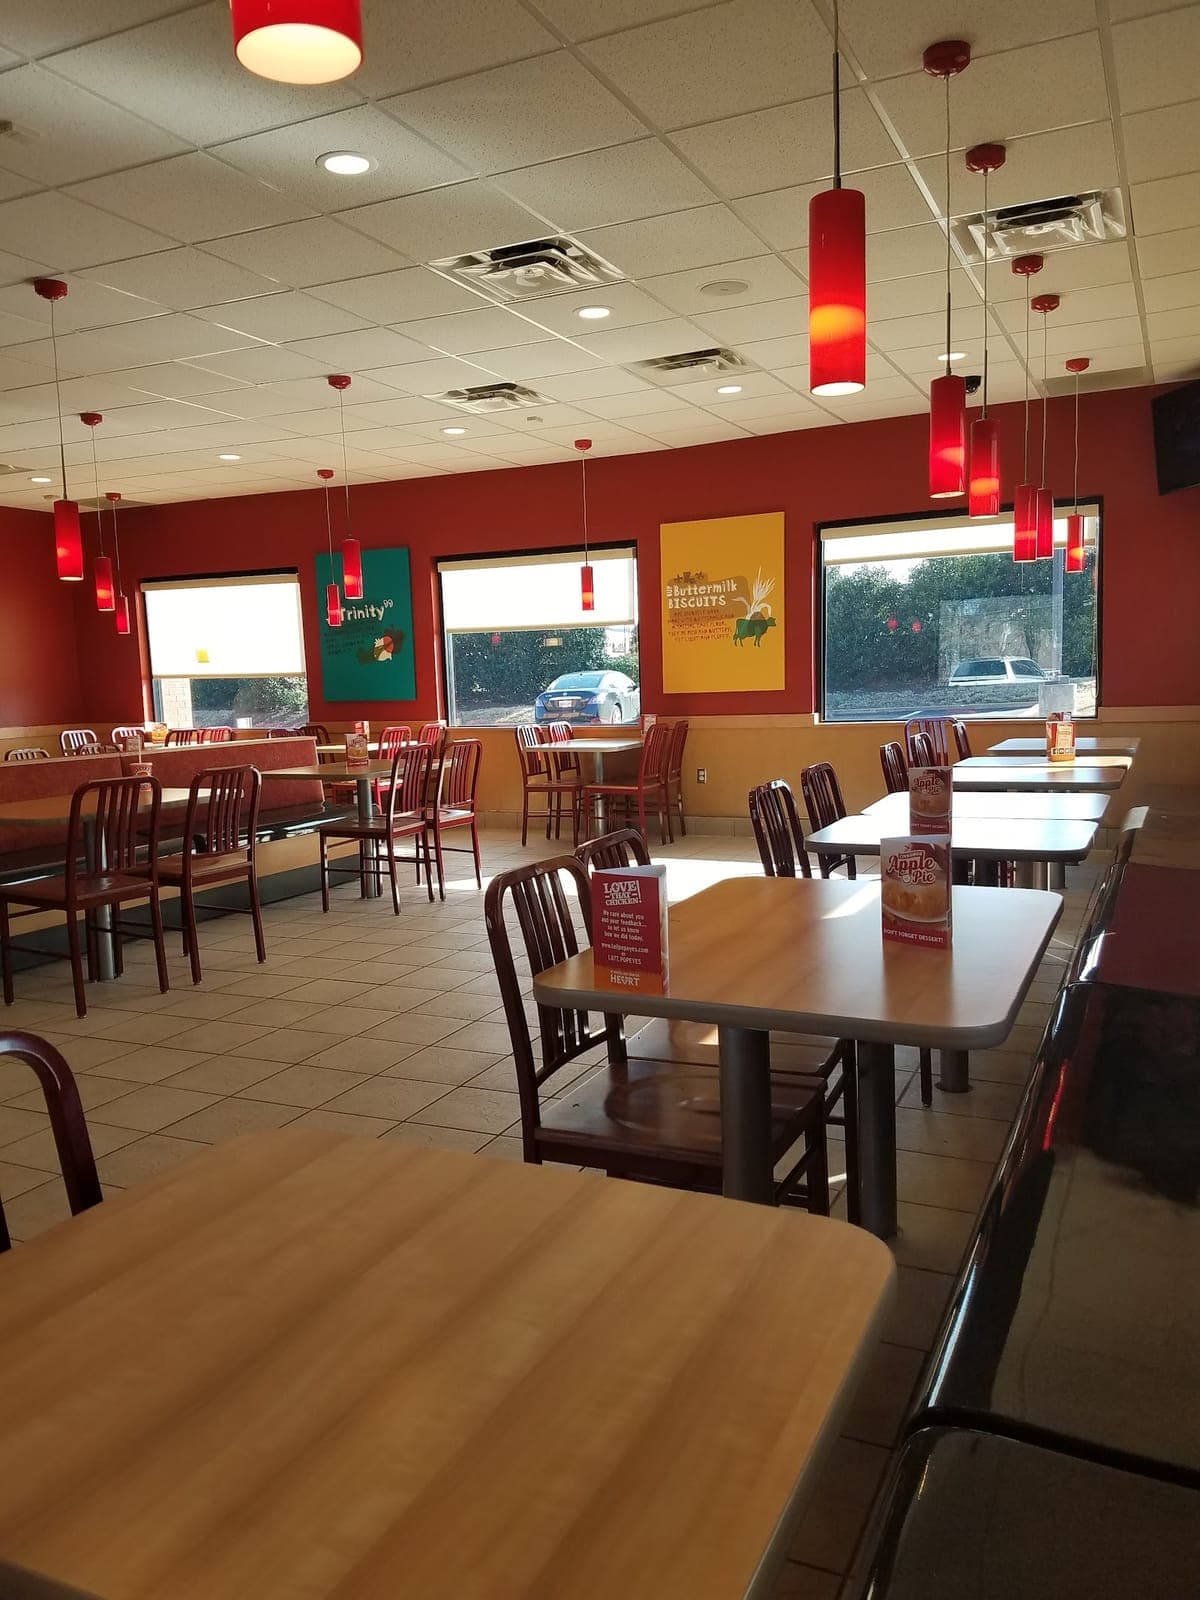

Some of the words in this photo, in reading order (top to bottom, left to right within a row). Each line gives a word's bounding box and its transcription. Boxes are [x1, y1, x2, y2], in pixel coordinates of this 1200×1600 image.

[673, 579, 737, 597] Buttermilk
[668, 596, 727, 609] BISCUITS
[887, 852, 936, 877] Apple
[911, 869, 936, 885] Pie
[603, 881, 636, 894] LOVE
[898, 930, 918, 940] FORGET
[919, 934, 944, 943] DESSERT!
